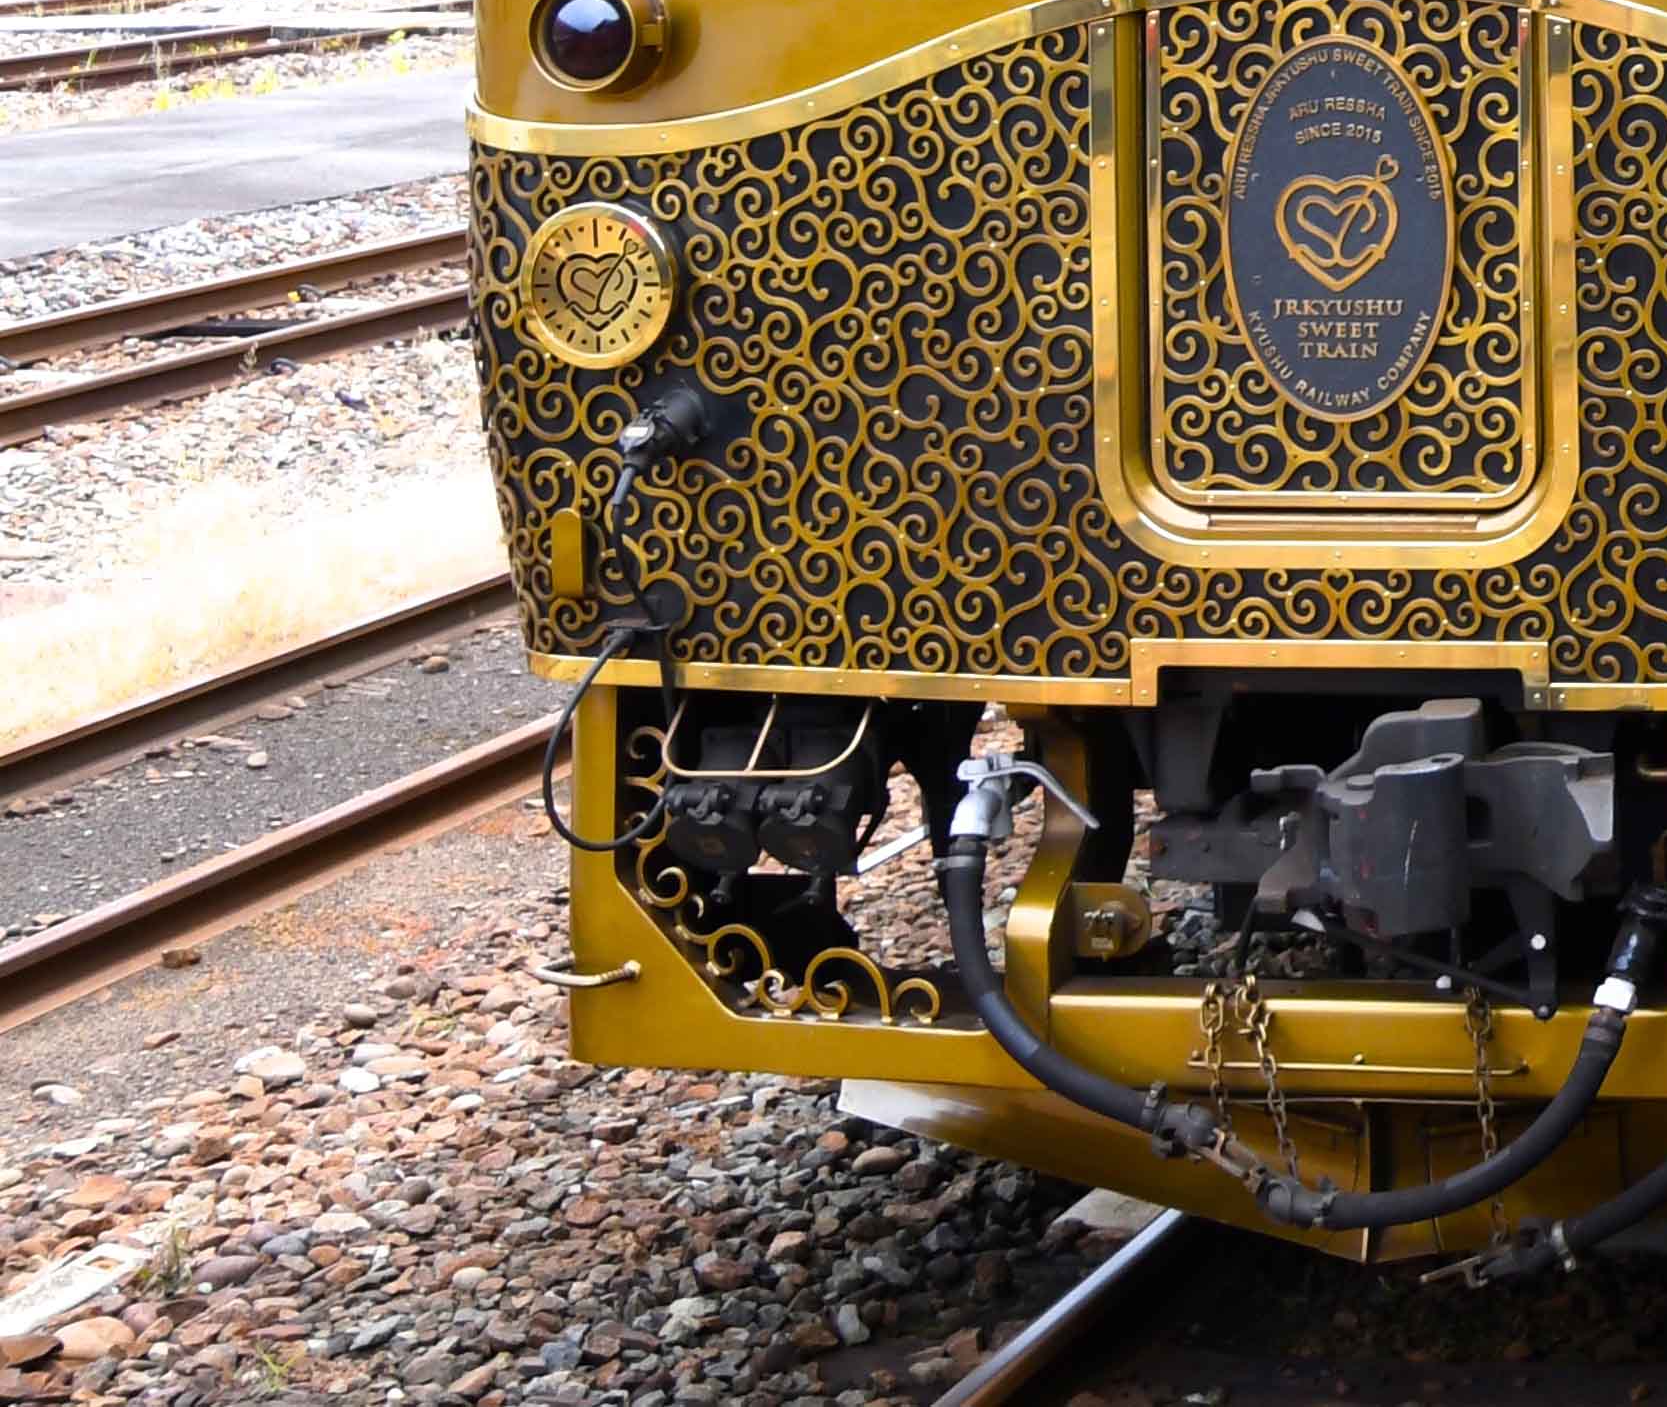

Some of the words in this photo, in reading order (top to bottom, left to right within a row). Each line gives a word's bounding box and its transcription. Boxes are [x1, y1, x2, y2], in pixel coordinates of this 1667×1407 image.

[1288, 97, 1320, 122] ARU
[1324, 95, 1386, 122] RESSHA
[1295, 121, 1342, 145] SINCE
[1345, 122, 1383, 145] 2015
[1272, 297, 1404, 319] JRKYUSHU
[1297, 321, 1380, 339] SWEET
[1248, 308, 1294, 381] KYUSHU
[1295, 377, 1371, 407] RAILWAY
[1376, 309, 1432, 391] COMPANY
[1298, 341, 1379, 360] TRAIN
